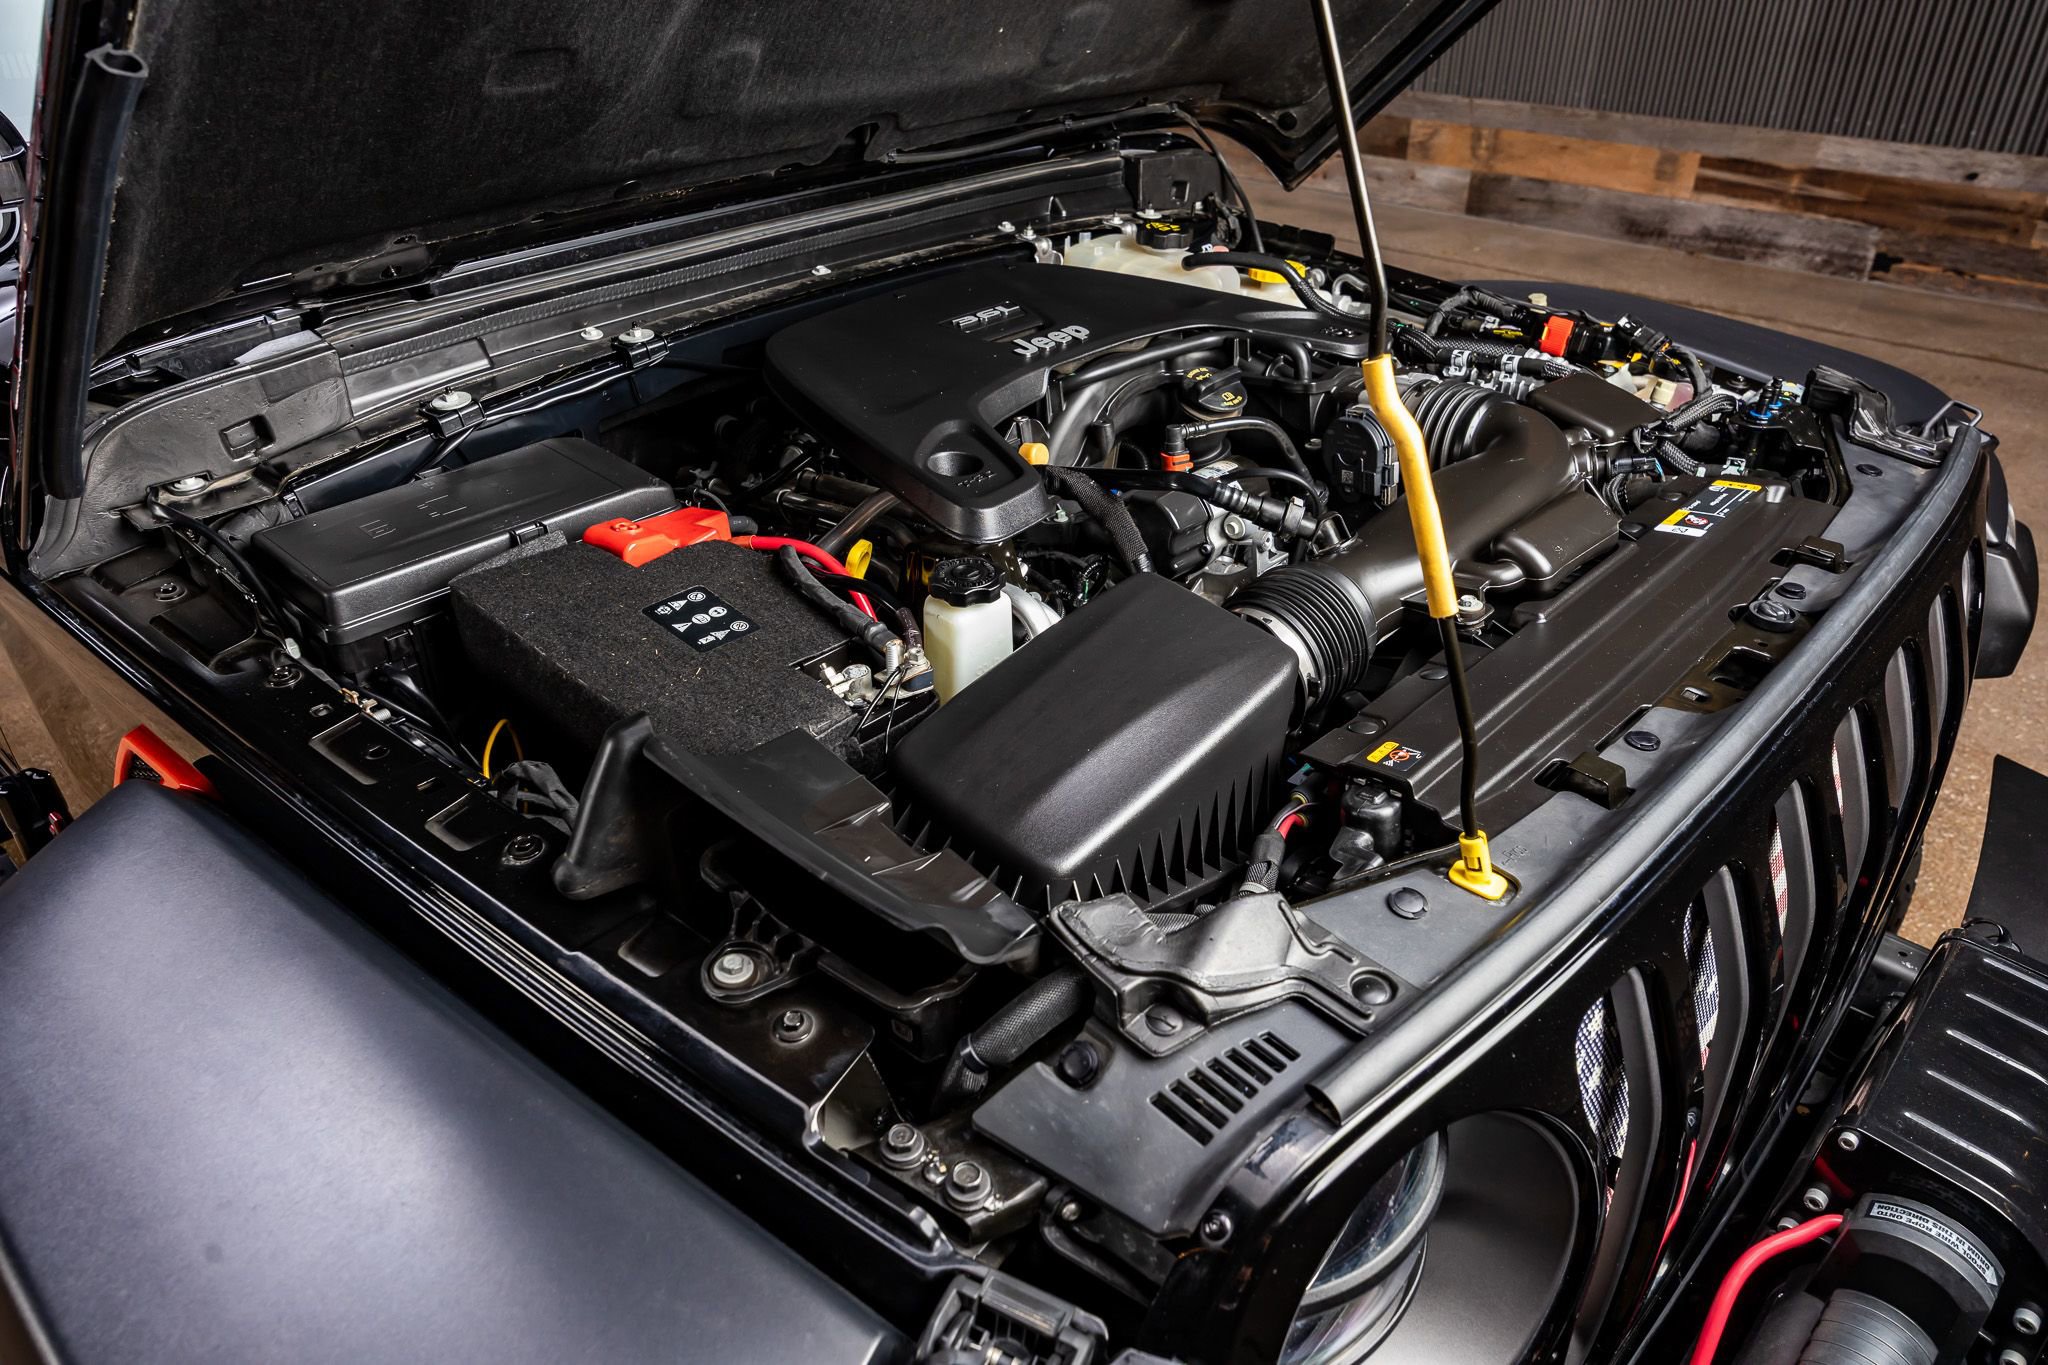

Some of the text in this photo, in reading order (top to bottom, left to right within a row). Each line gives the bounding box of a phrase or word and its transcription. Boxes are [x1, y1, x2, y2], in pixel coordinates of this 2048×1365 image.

[1012, 325, 1090, 357] Jeep
[1876, 1210, 1987, 1275] SPOOL WIRE ROPE ONTO
[1877, 1204, 1990, 1270] DRUM IN THIS DIRECTION
